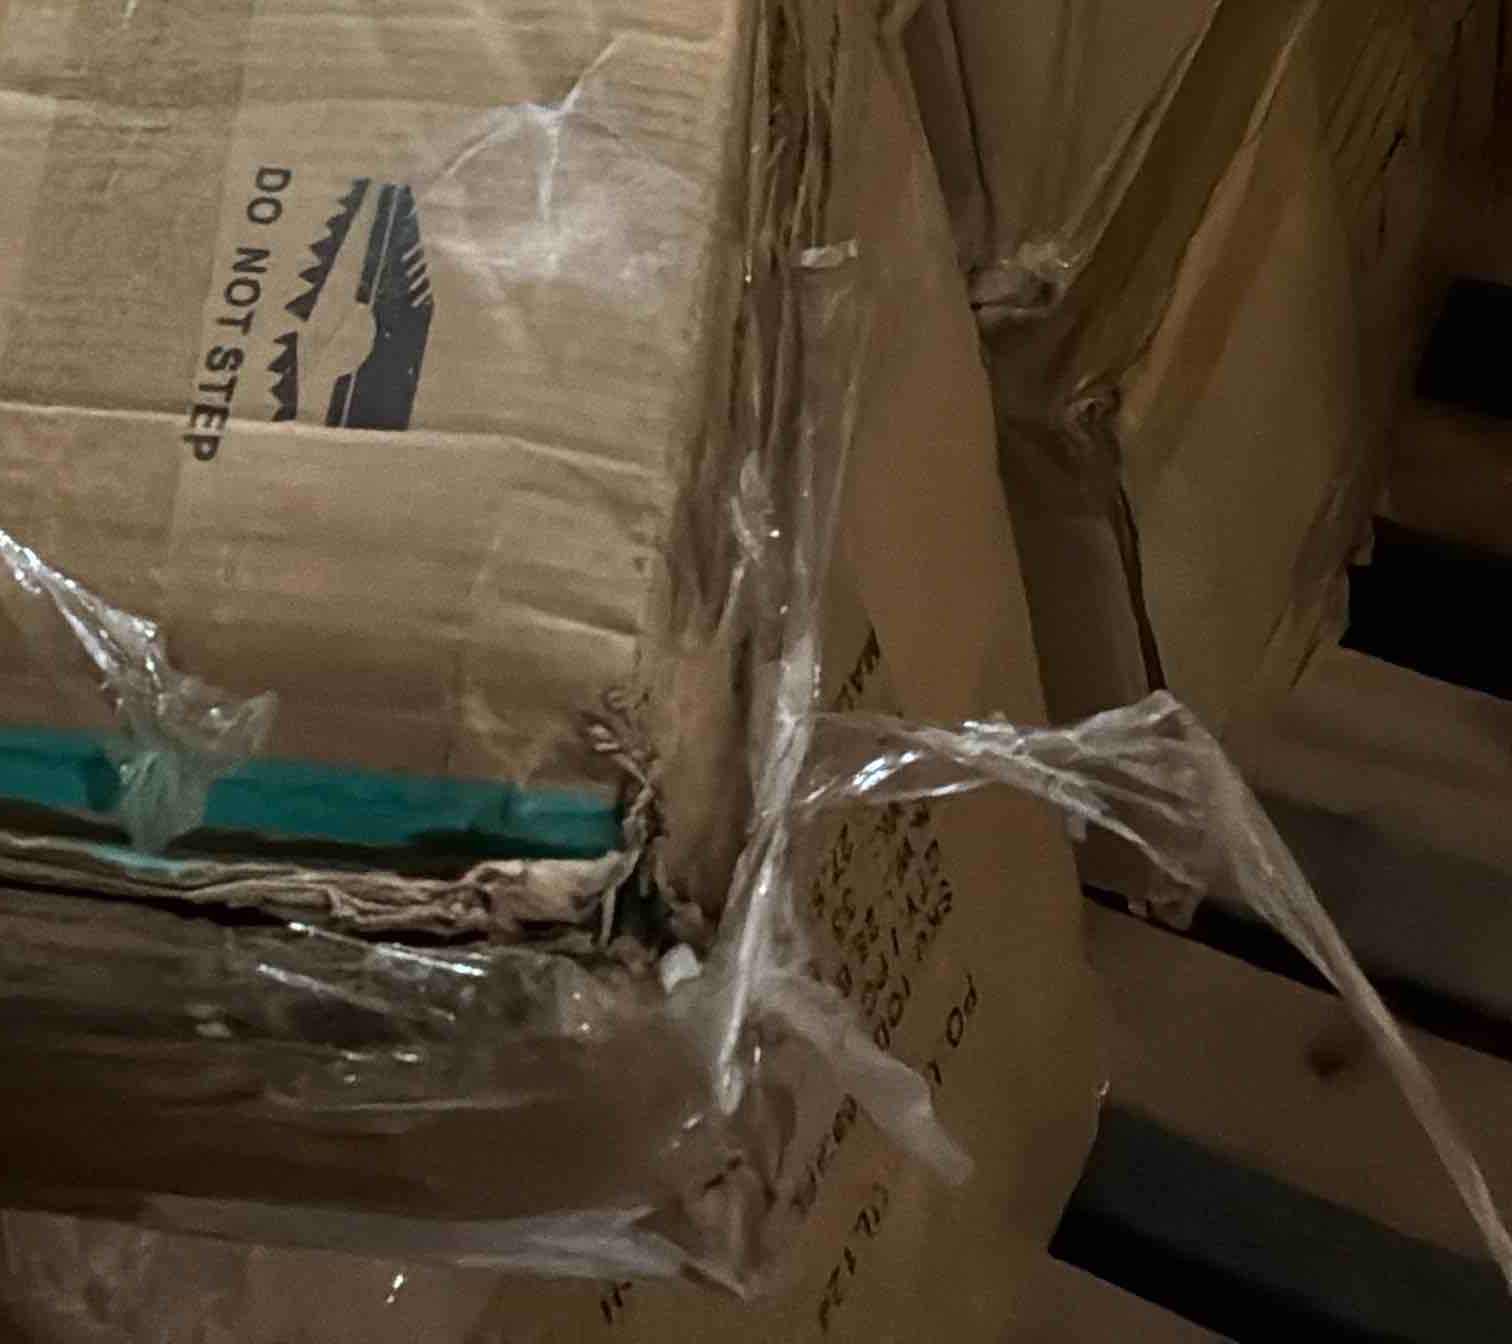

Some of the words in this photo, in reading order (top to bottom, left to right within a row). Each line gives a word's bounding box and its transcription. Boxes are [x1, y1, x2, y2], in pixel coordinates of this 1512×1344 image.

[246, 167, 292, 225] DO
[215, 247, 271, 336] NOT
[181, 345, 245, 462] STEP
